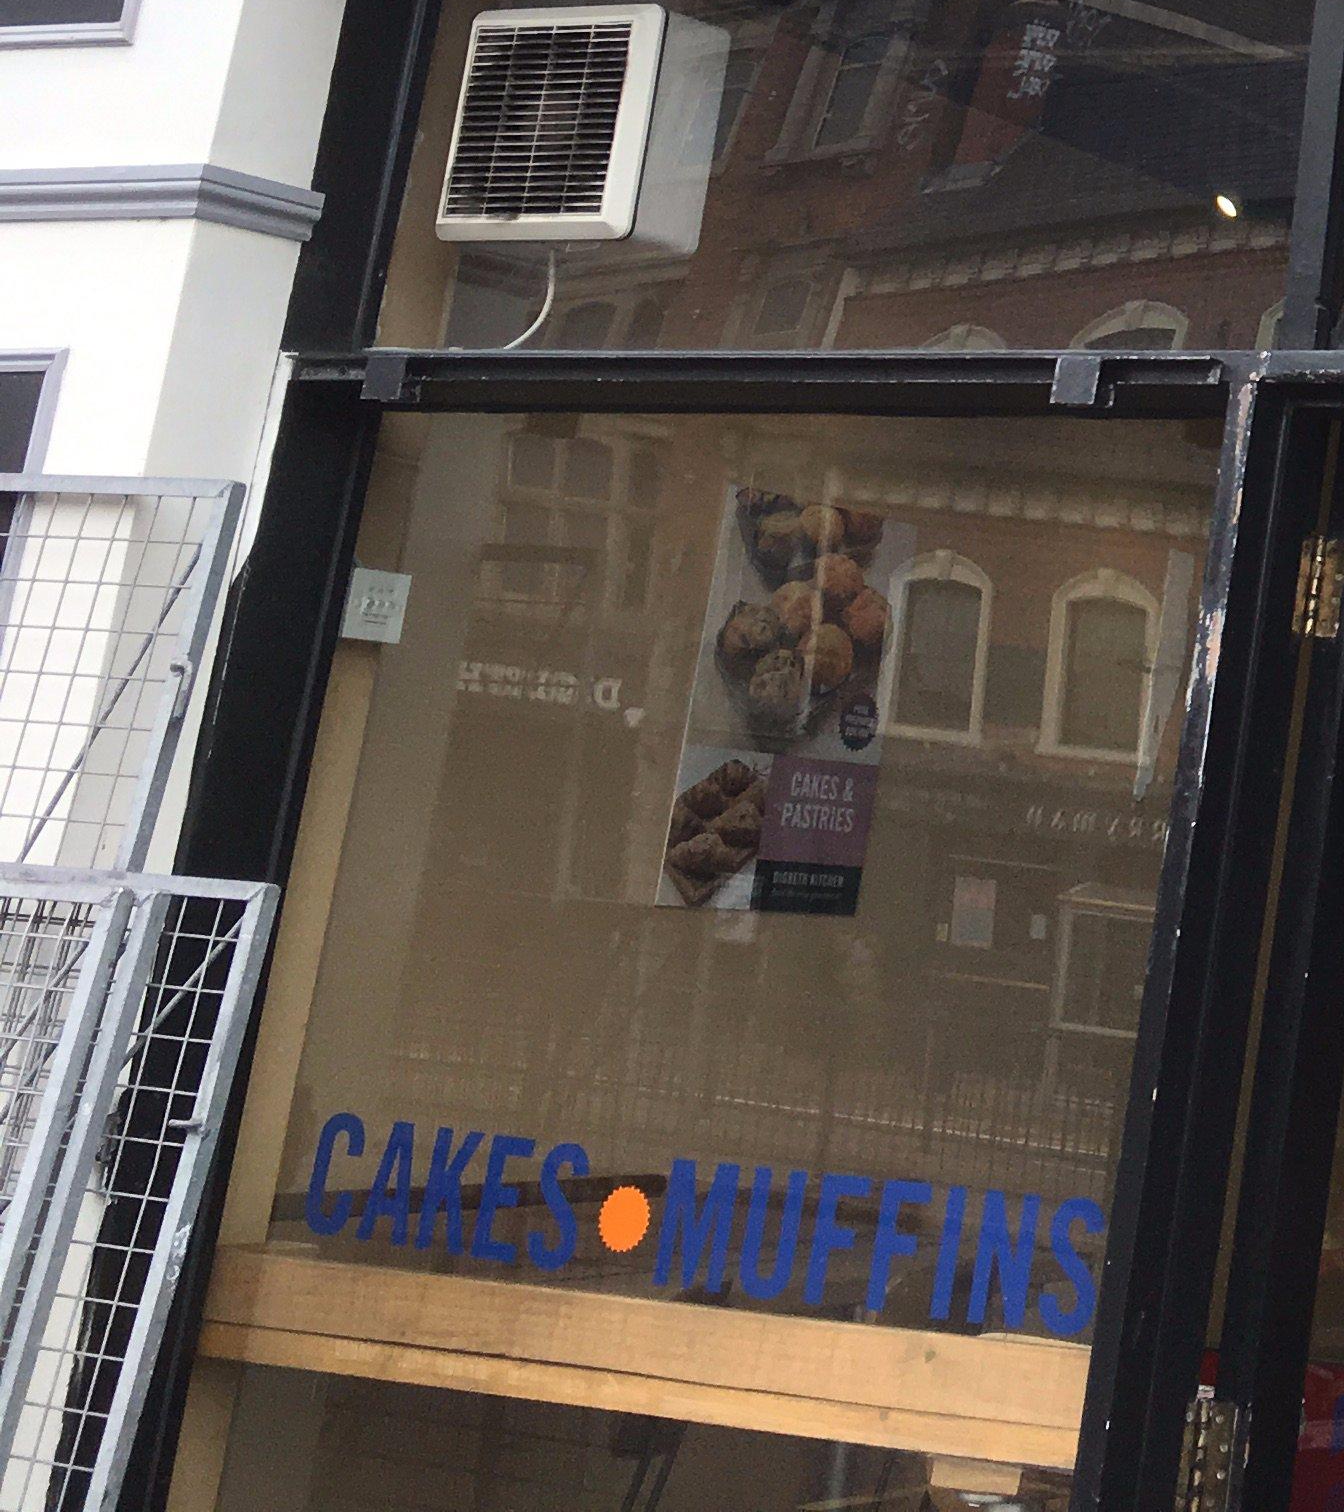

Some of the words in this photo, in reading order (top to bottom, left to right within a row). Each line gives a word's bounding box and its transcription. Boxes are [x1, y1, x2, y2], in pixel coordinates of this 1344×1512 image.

[790, 771, 840, 800] CAKES
[842, 777, 855, 801] &
[780, 802, 856, 833] PASTRIES
[304, 1110, 590, 1272] CAKES
[652, 1157, 1107, 1337] MUFFINS
